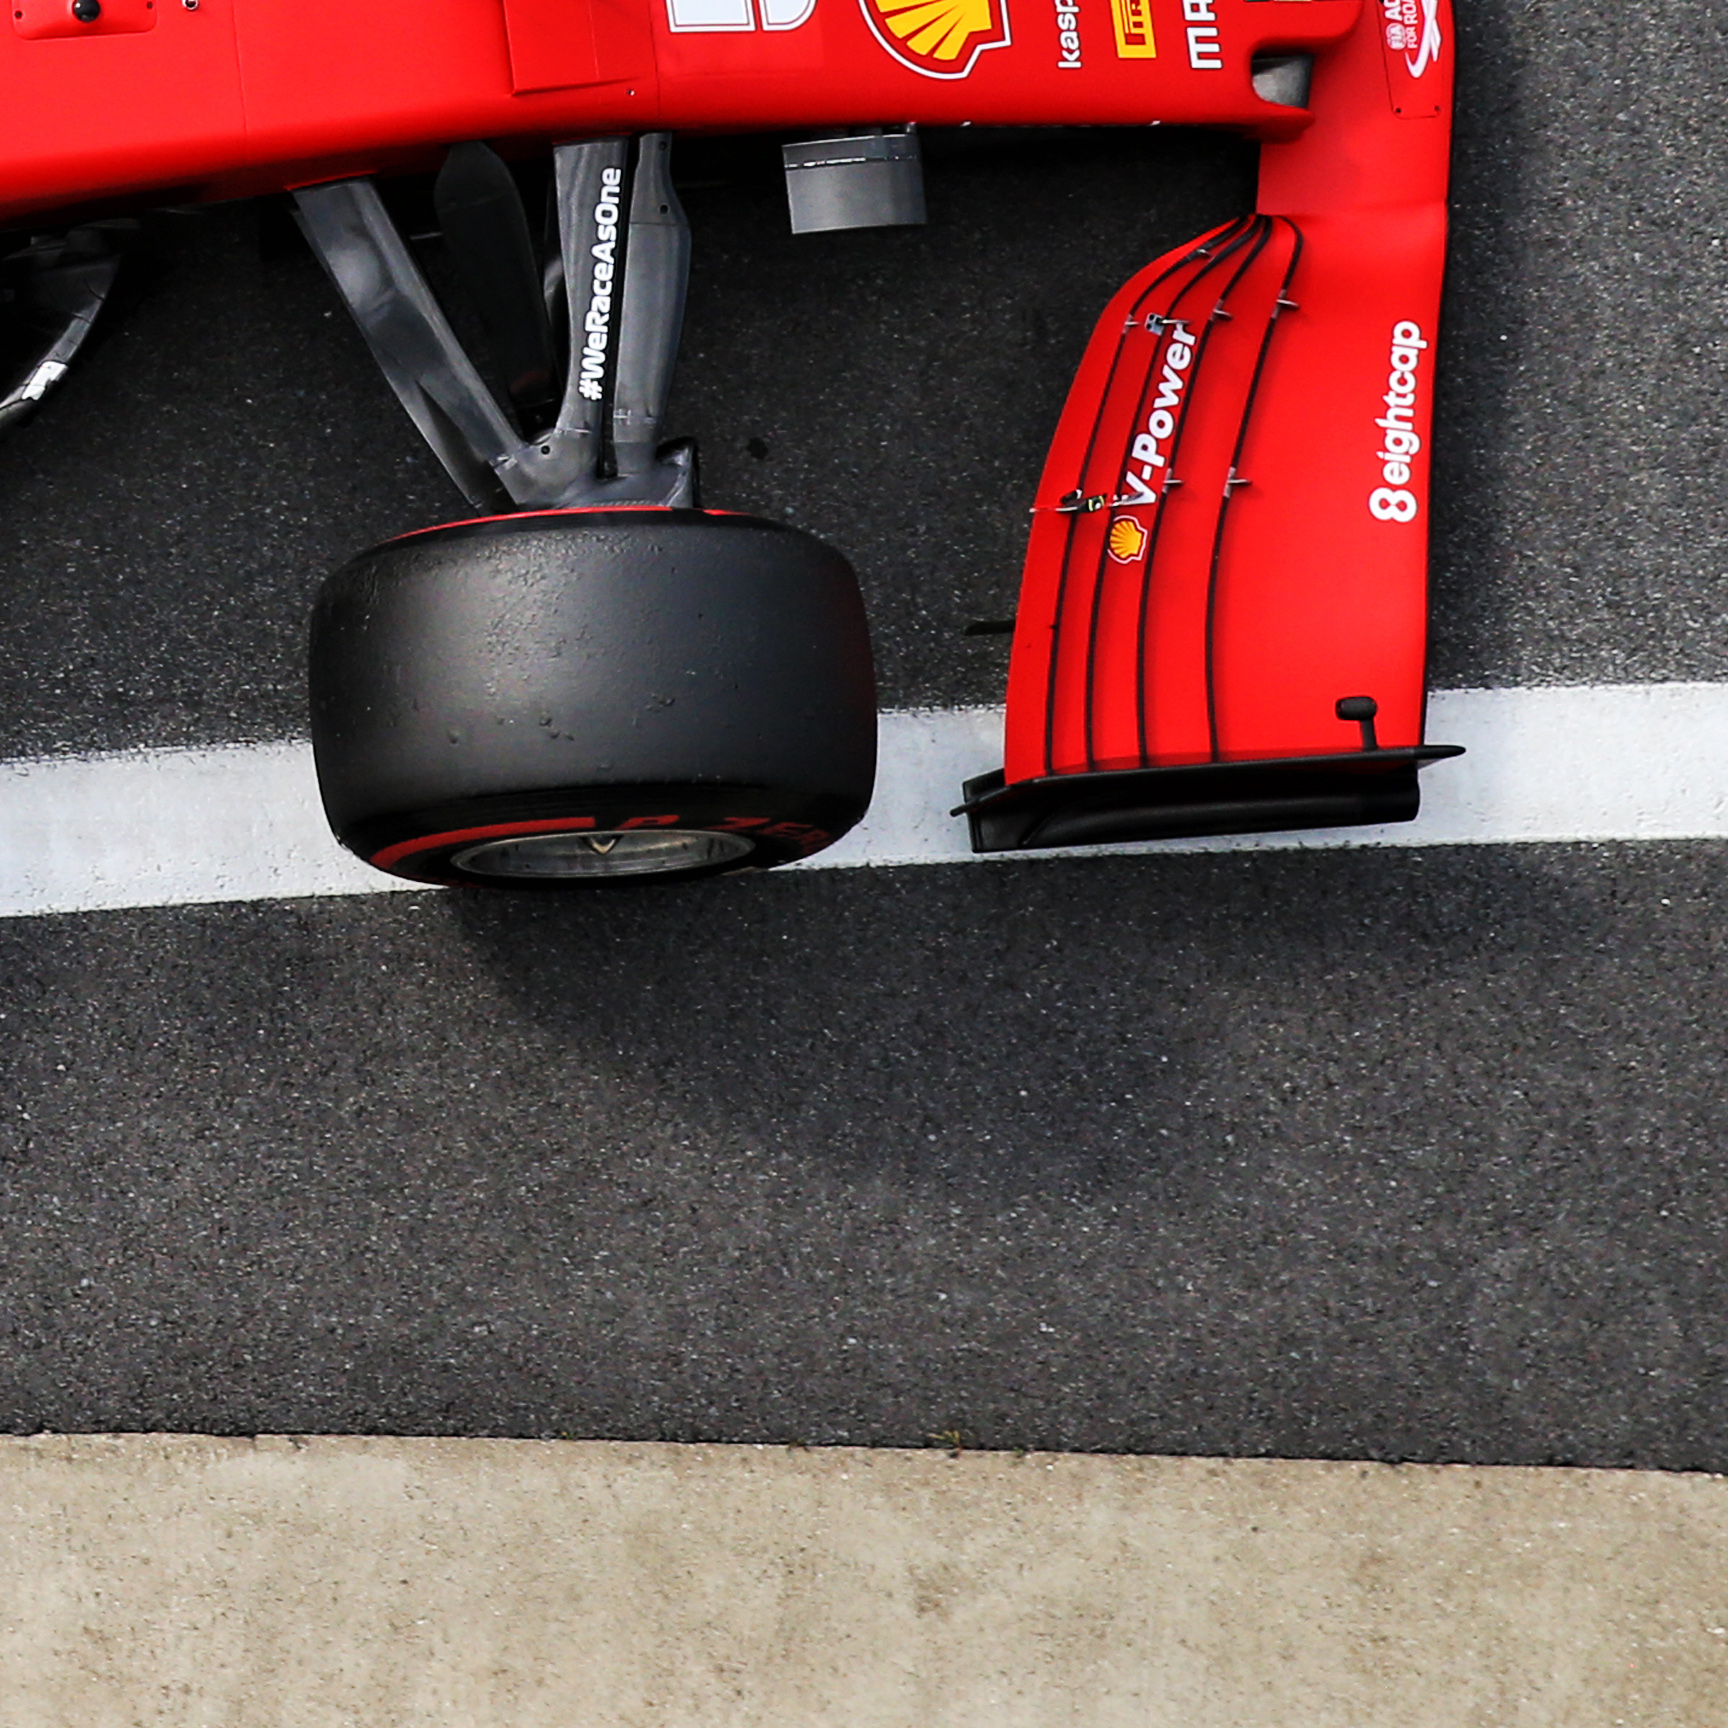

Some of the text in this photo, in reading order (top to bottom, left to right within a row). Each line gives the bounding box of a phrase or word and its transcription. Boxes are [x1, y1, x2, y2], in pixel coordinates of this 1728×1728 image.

[1405, 26, 1418, 49] FOR
[577, 167, 622, 401] #WeRaceAsOne
[1116, 321, 1197, 506] V-Power
[1374, 320, 1428, 485] eightcap
